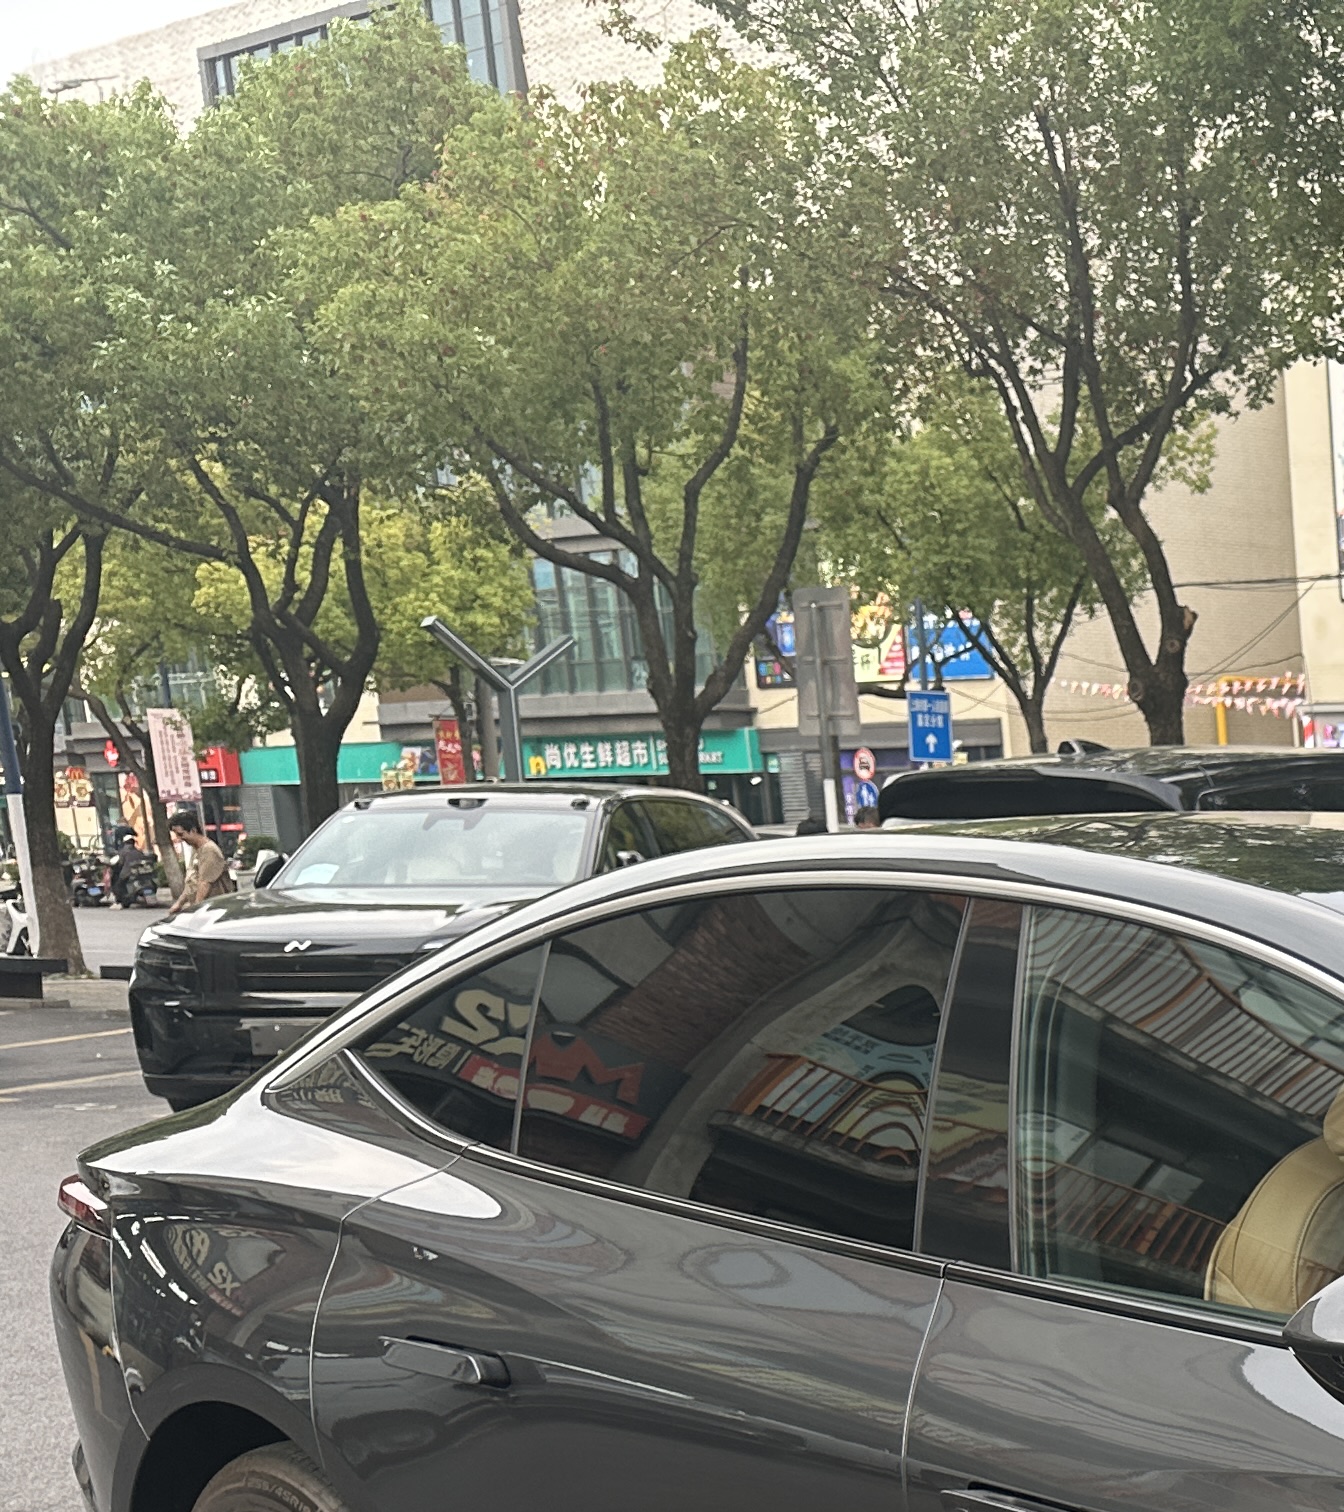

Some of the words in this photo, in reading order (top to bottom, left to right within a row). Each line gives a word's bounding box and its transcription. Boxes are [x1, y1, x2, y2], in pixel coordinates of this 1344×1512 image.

[544, 738, 651, 770] 尚优生鲜超市
